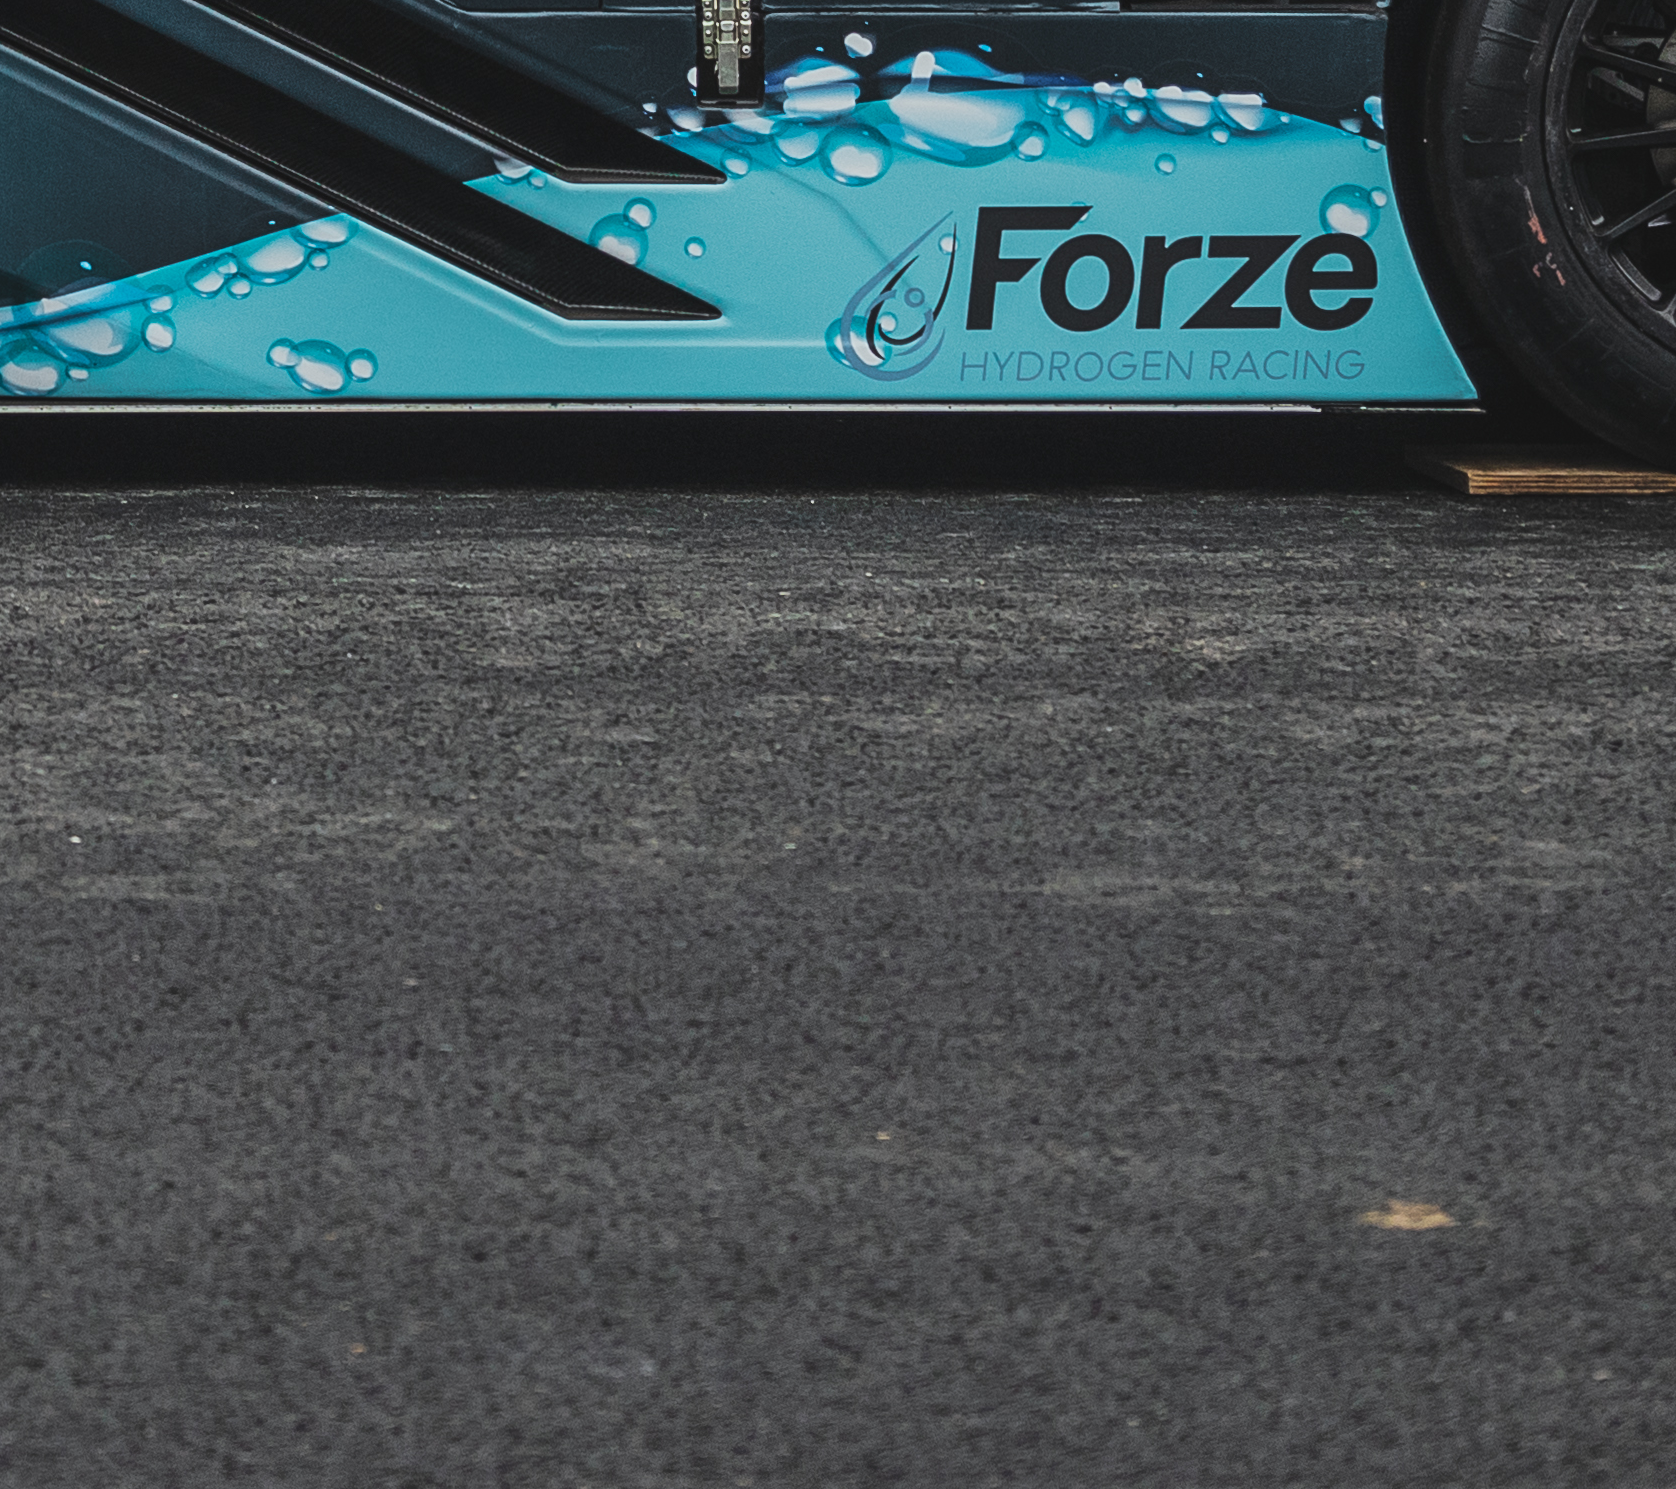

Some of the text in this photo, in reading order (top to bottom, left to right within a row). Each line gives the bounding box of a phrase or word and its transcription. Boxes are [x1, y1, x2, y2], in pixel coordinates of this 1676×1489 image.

[965, 204, 1380, 332] Forze
[960, 349, 1368, 382] HYDROGEN RACING
